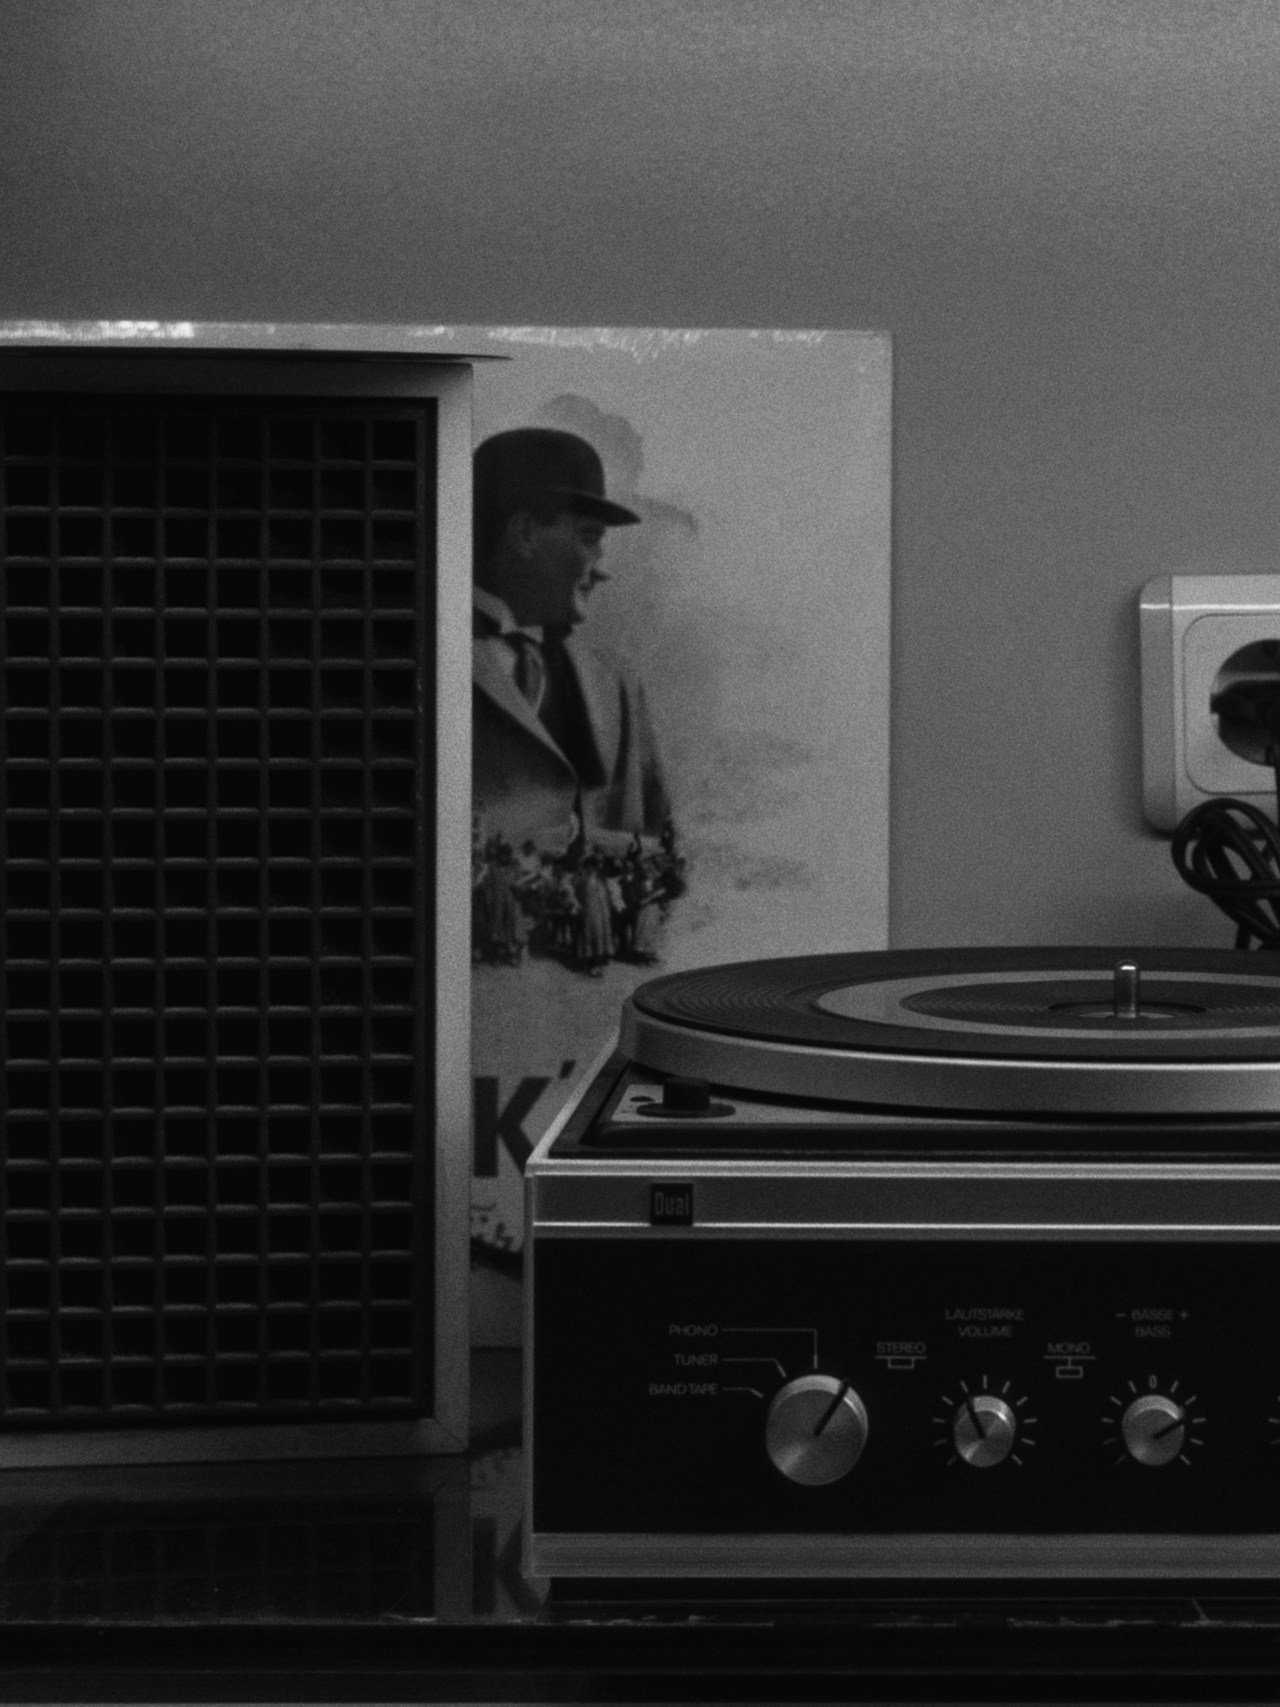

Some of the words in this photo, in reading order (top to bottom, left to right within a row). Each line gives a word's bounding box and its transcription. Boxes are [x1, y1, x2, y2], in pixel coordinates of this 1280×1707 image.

[655, 1192, 690, 1216] Dual
[946, 1307, 1024, 1320] LAUTSTÄRKE
[669, 1325, 718, 1336] PHONO
[958, 1325, 1012, 1337] VOLUME
[1135, 1325, 1171, 1337] BASS
[876, 1342, 926, 1354] STEREO
[1048, 1342, 1090, 1354] MONO
[674, 1354, 718, 1366] TUNER
[649, 1384, 686, 1395] BAND
[688, 1384, 718, 1395] TAPE
